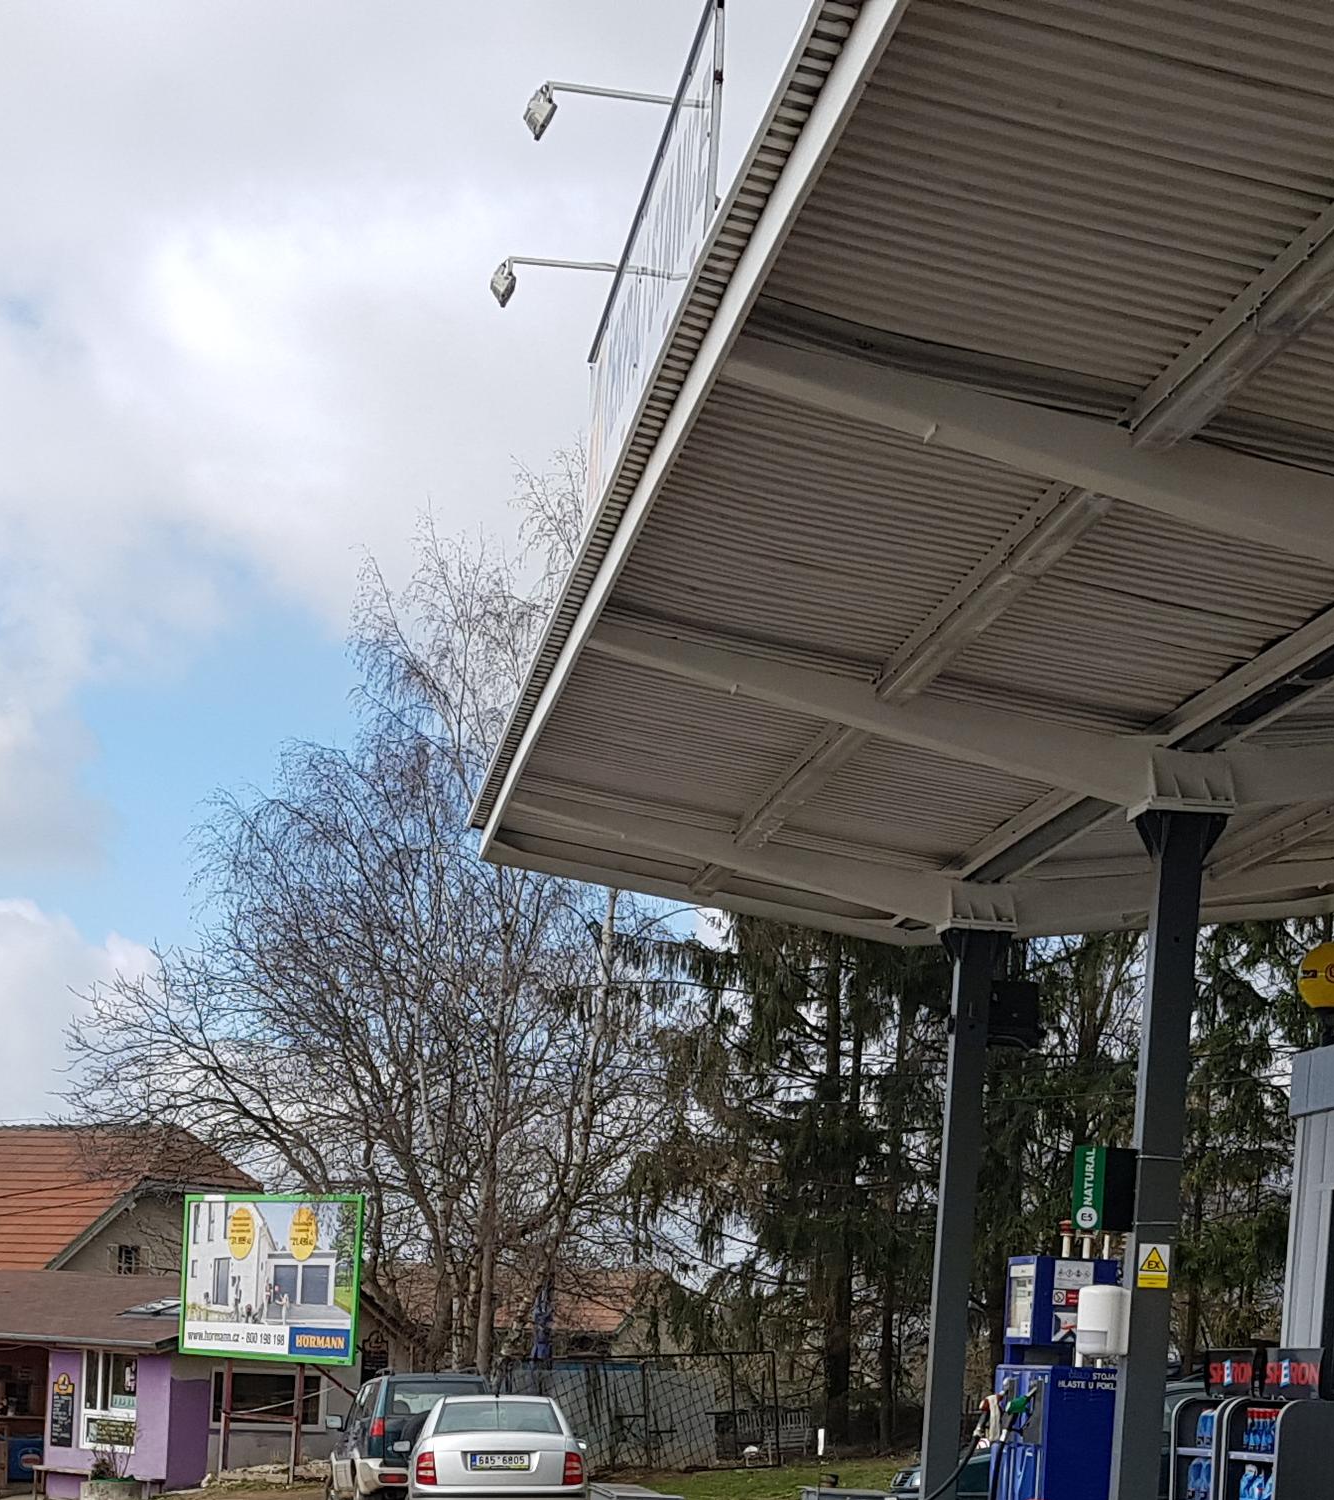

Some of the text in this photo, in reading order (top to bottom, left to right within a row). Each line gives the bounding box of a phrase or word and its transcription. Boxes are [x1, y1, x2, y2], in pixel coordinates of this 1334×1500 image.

[1083, 1148, 1097, 1206] NATURAL
[1081, 1212, 1093, 1222] E5
[1147, 1260, 1160, 1269] EX
[1265, 1359, 1320, 1387] SHERON
[1058, 1381, 1086, 1389] HLASTE
[1096, 1382, 1117, 1391] POKL
